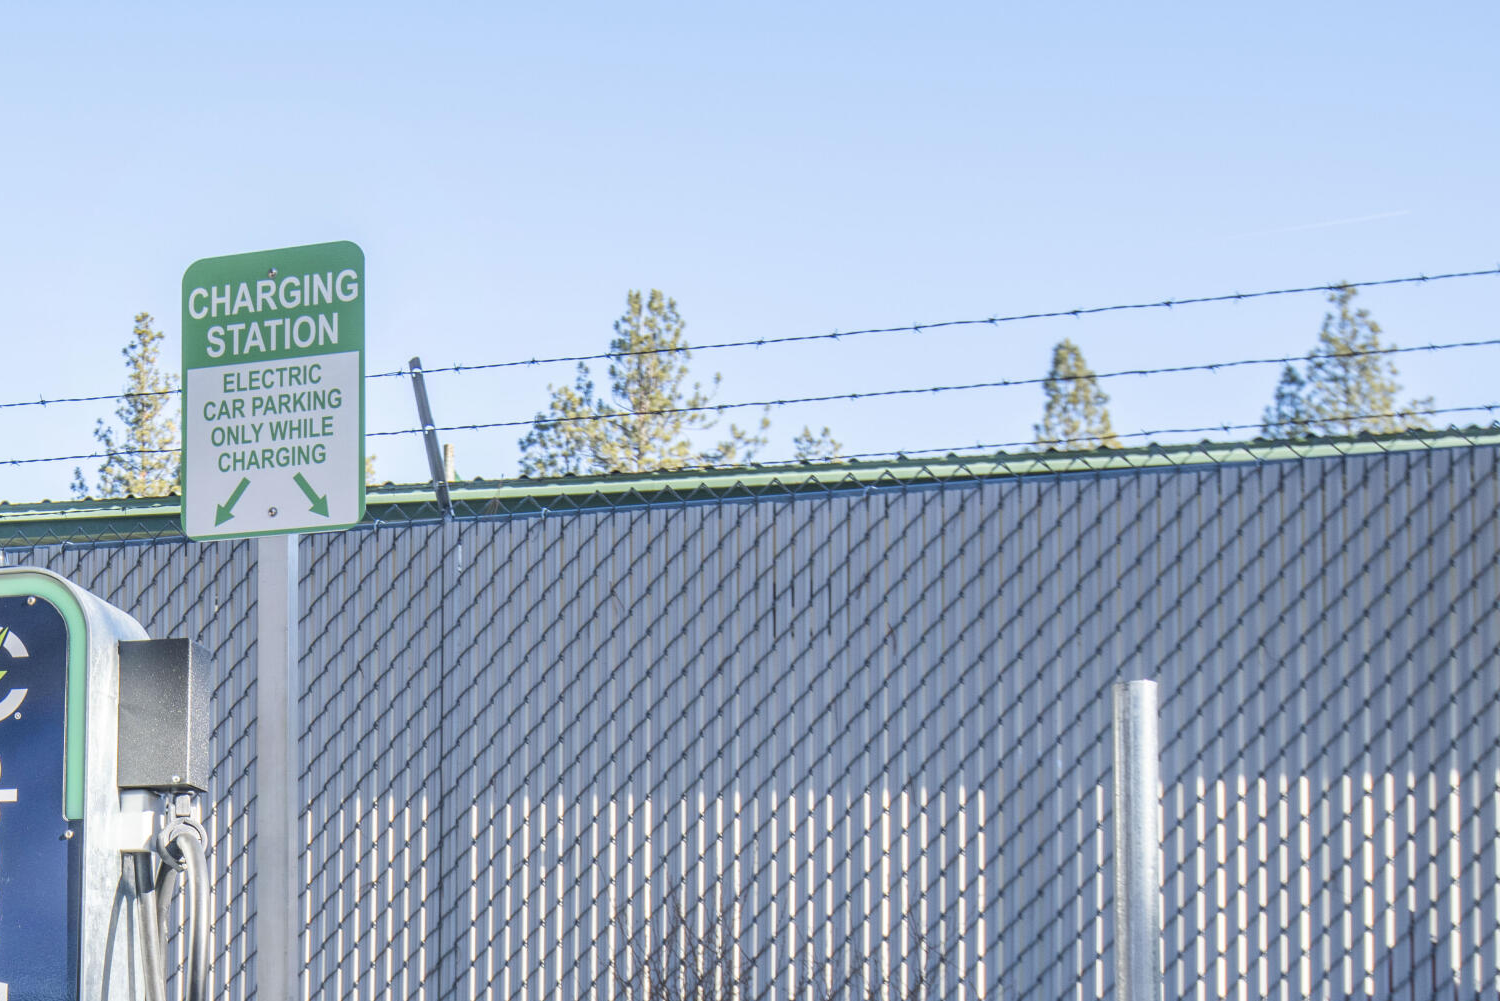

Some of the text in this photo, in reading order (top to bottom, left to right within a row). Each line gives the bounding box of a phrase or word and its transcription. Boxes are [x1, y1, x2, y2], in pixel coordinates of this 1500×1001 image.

[188, 269, 359, 320] CHARGING
[206, 312, 339, 358] STATION
[223, 363, 322, 393] ELECTRIC
[203, 388, 342, 422] CAR PARKING
[211, 416, 334, 447] ONLY WHILE
[218, 443, 326, 473] CHARGING
